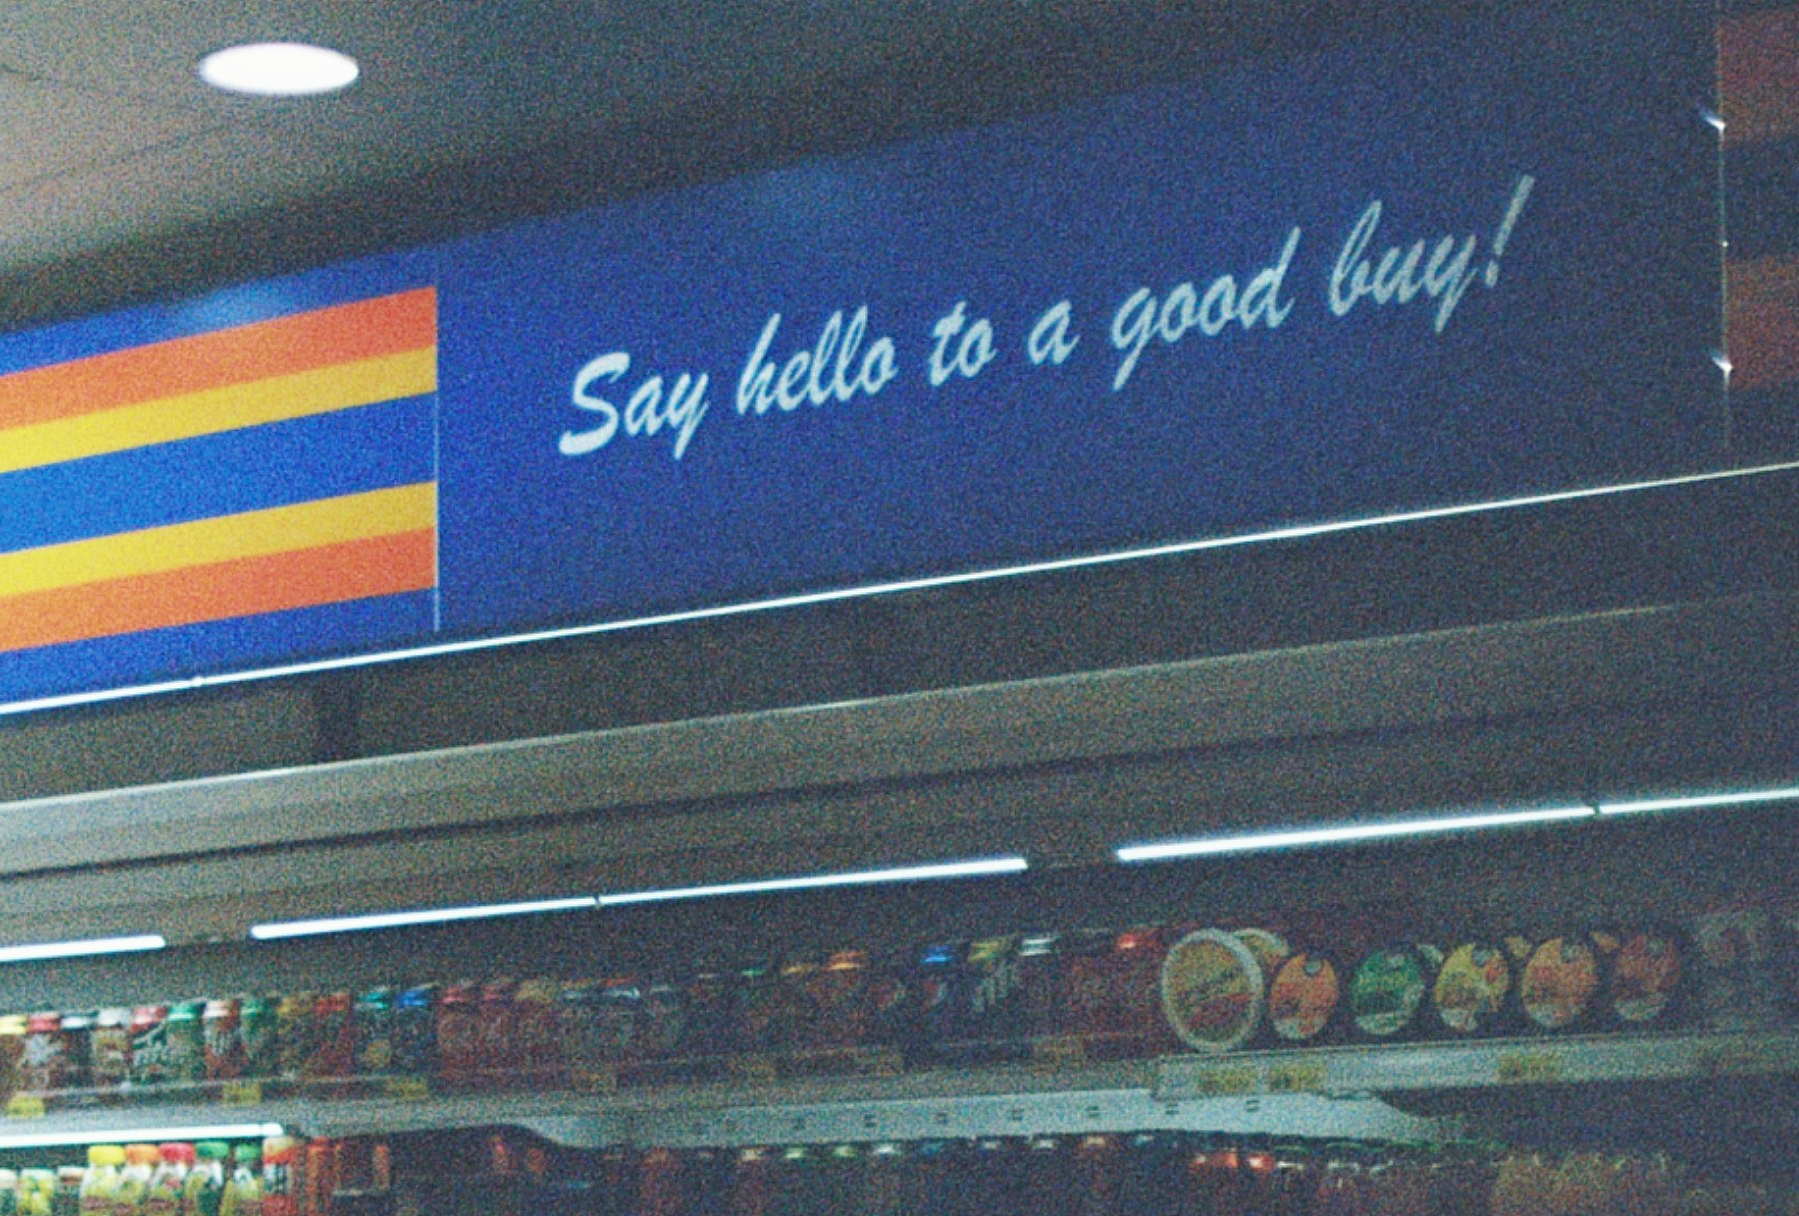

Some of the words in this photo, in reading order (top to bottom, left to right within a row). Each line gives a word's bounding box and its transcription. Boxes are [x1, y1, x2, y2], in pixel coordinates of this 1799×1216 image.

[558, 351, 709, 459] Say
[735, 305, 899, 416] hello
[928, 299, 998, 388] to
[1027, 298, 1079, 365] a
[1110, 226, 1301, 390] good
[1327, 174, 1535, 333] buy!
